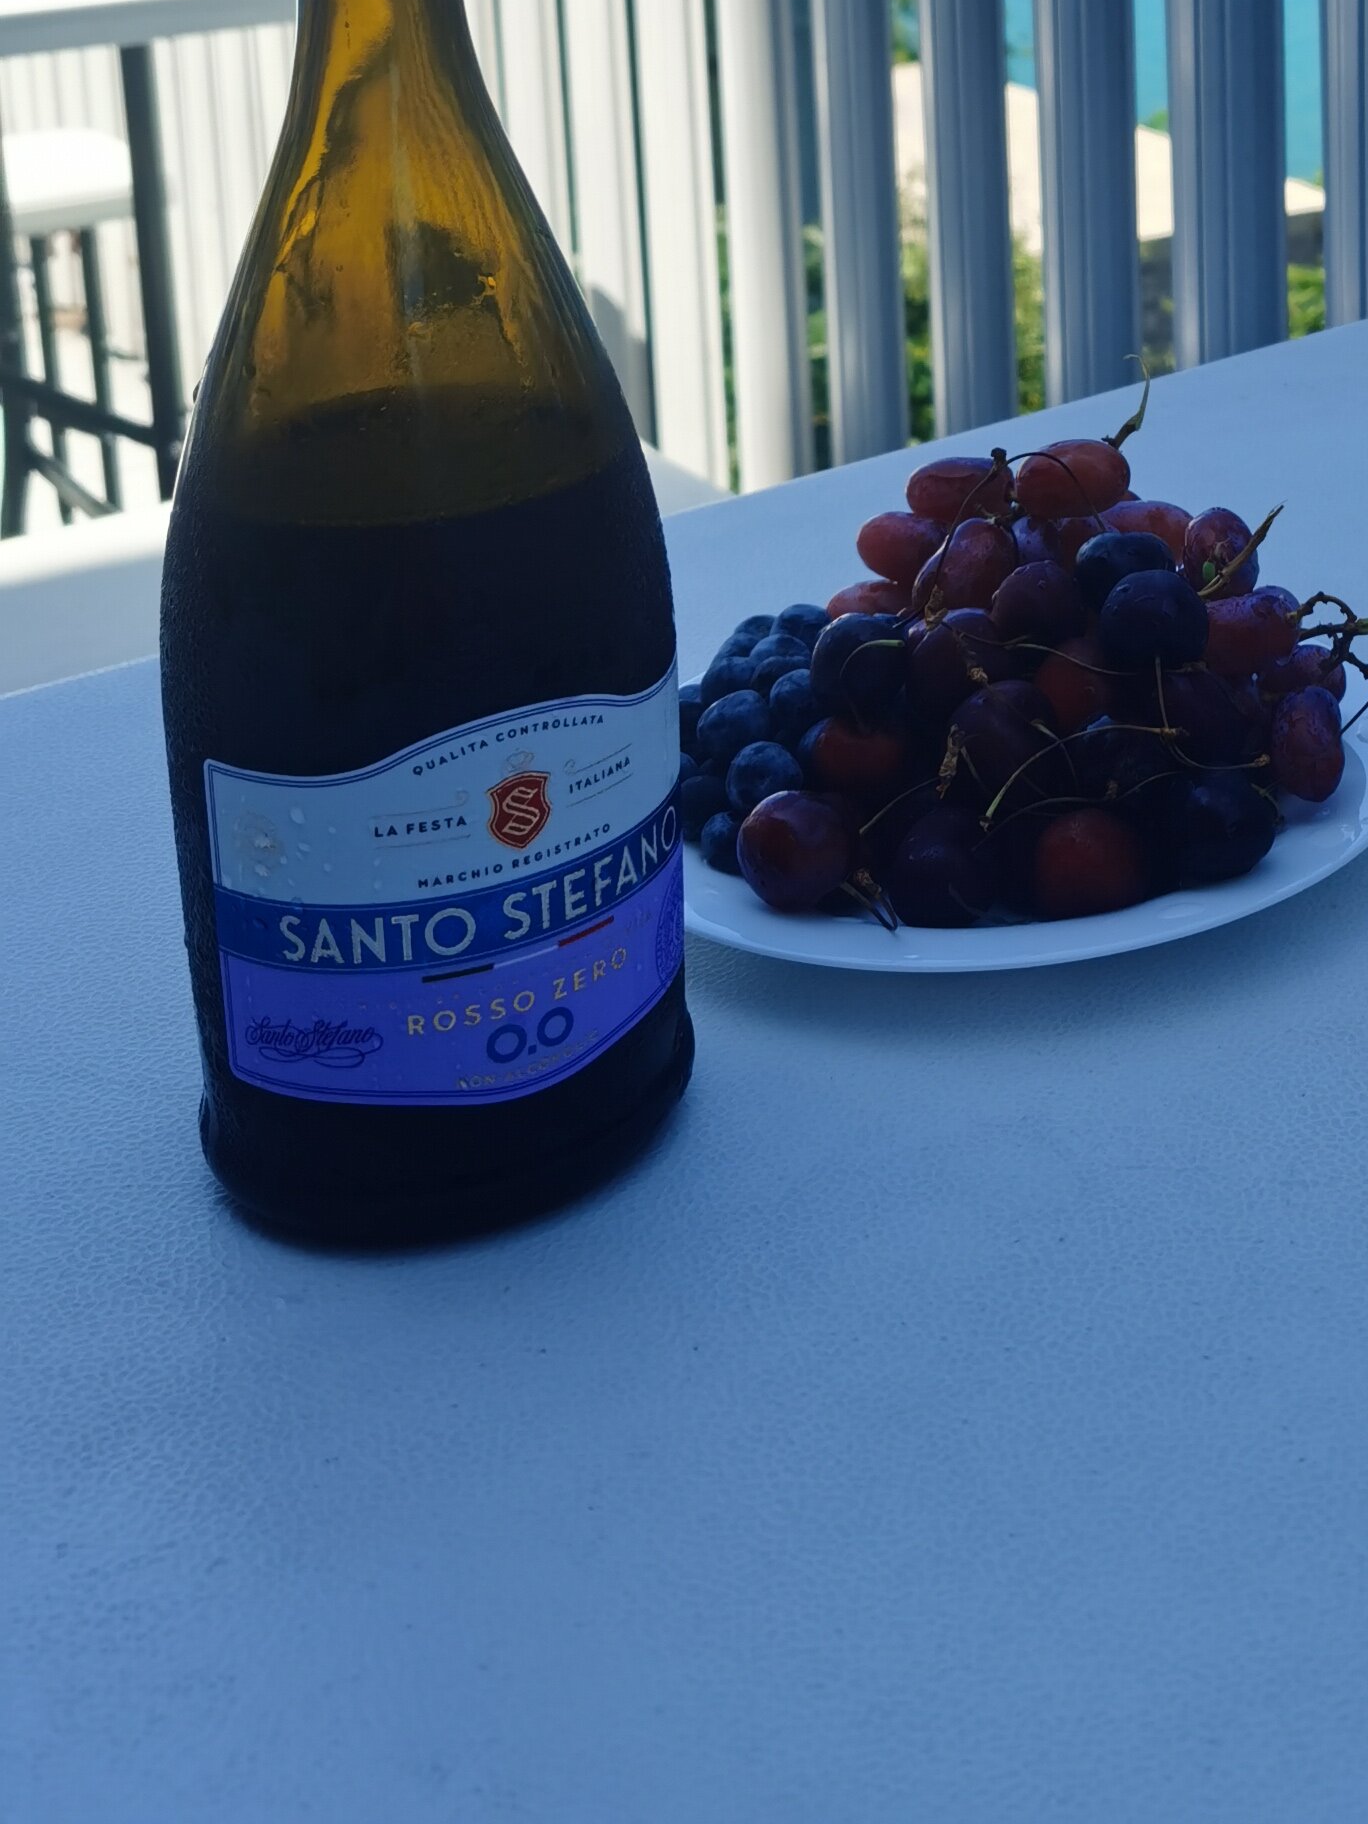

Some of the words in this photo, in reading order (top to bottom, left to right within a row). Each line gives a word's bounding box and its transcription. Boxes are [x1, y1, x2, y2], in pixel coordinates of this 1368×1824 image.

[412, 739, 489, 776] QUALITA
[495, 714, 604, 743] CONTROLLATA
[568, 756, 631, 794] ITALIANA
[374, 824, 399, 838] LA
[406, 815, 468, 835] FESTA
[417, 863, 504, 889] MARCHIO
[512, 823, 611, 869] REGISTRATO
[278, 906, 477, 965] SANTO
[502, 805, 677, 942] STEFANO
[407, 990, 536, 1036] ROSSO
[552, 947, 628, 1001] ZERO
[245, 1015, 297, 1047] Santo
[295, 1018, 383, 1055] Stefano
[486, 1006, 575, 1064] 0.0
